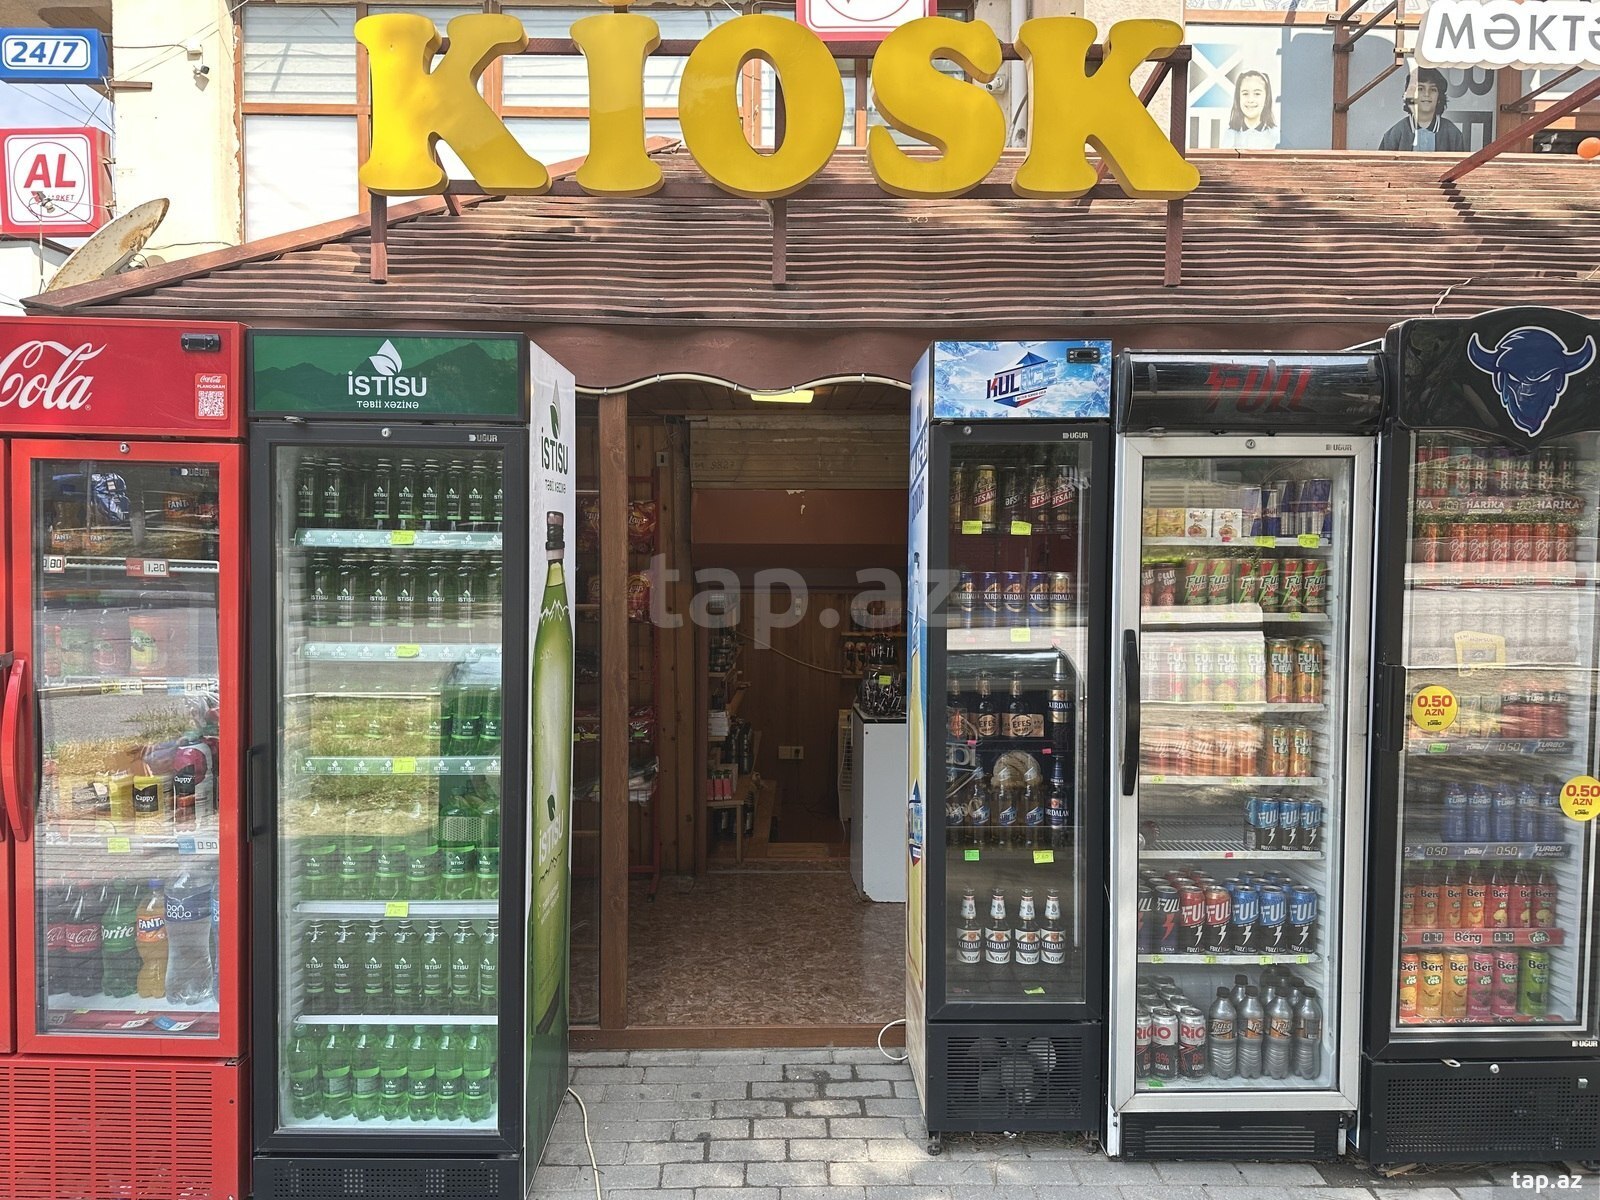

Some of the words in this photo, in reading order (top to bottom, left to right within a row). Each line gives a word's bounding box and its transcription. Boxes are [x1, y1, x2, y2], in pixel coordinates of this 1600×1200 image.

[11, 41, 79, 64] 24/7
[23, 153, 76, 188] AL
[1417, 695, 1453, 708] 0.50
[1566, 785, 1600, 798] 0.50
